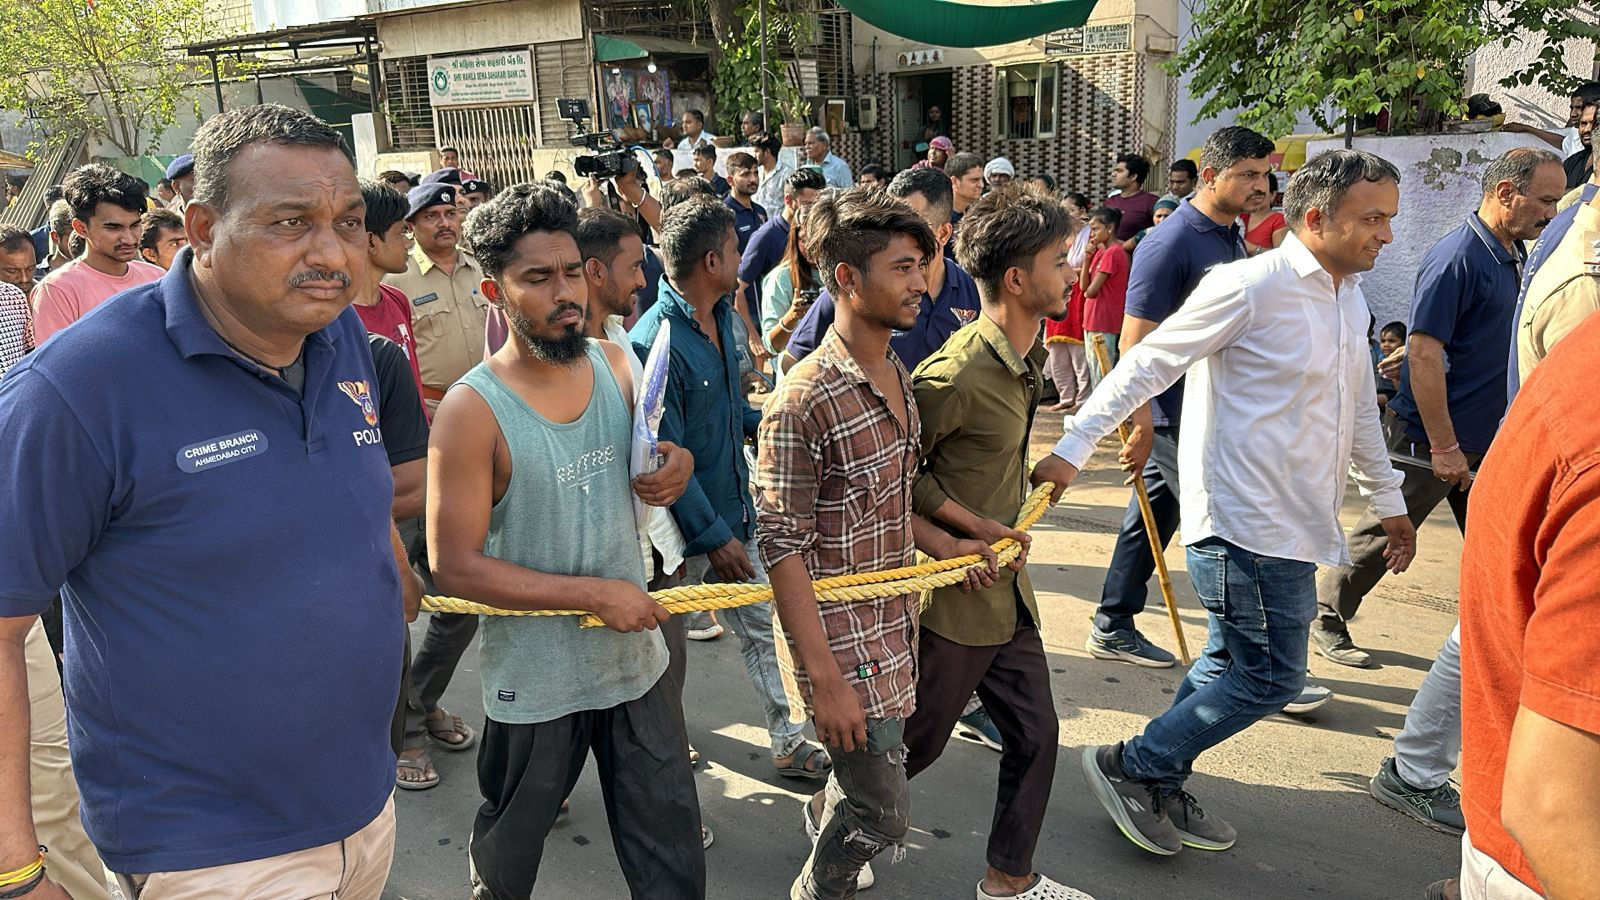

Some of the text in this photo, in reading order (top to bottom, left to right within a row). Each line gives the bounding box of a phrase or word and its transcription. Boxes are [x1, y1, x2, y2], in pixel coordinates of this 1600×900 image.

[1085, 43, 1127, 52] ADVOCATE
[507, 70, 518, 78] BANK
[185, 433, 259, 458] CRIME BRANCH
[353, 428, 380, 447] POLI
[195, 445, 256, 468] AHMEDABAD CITY
